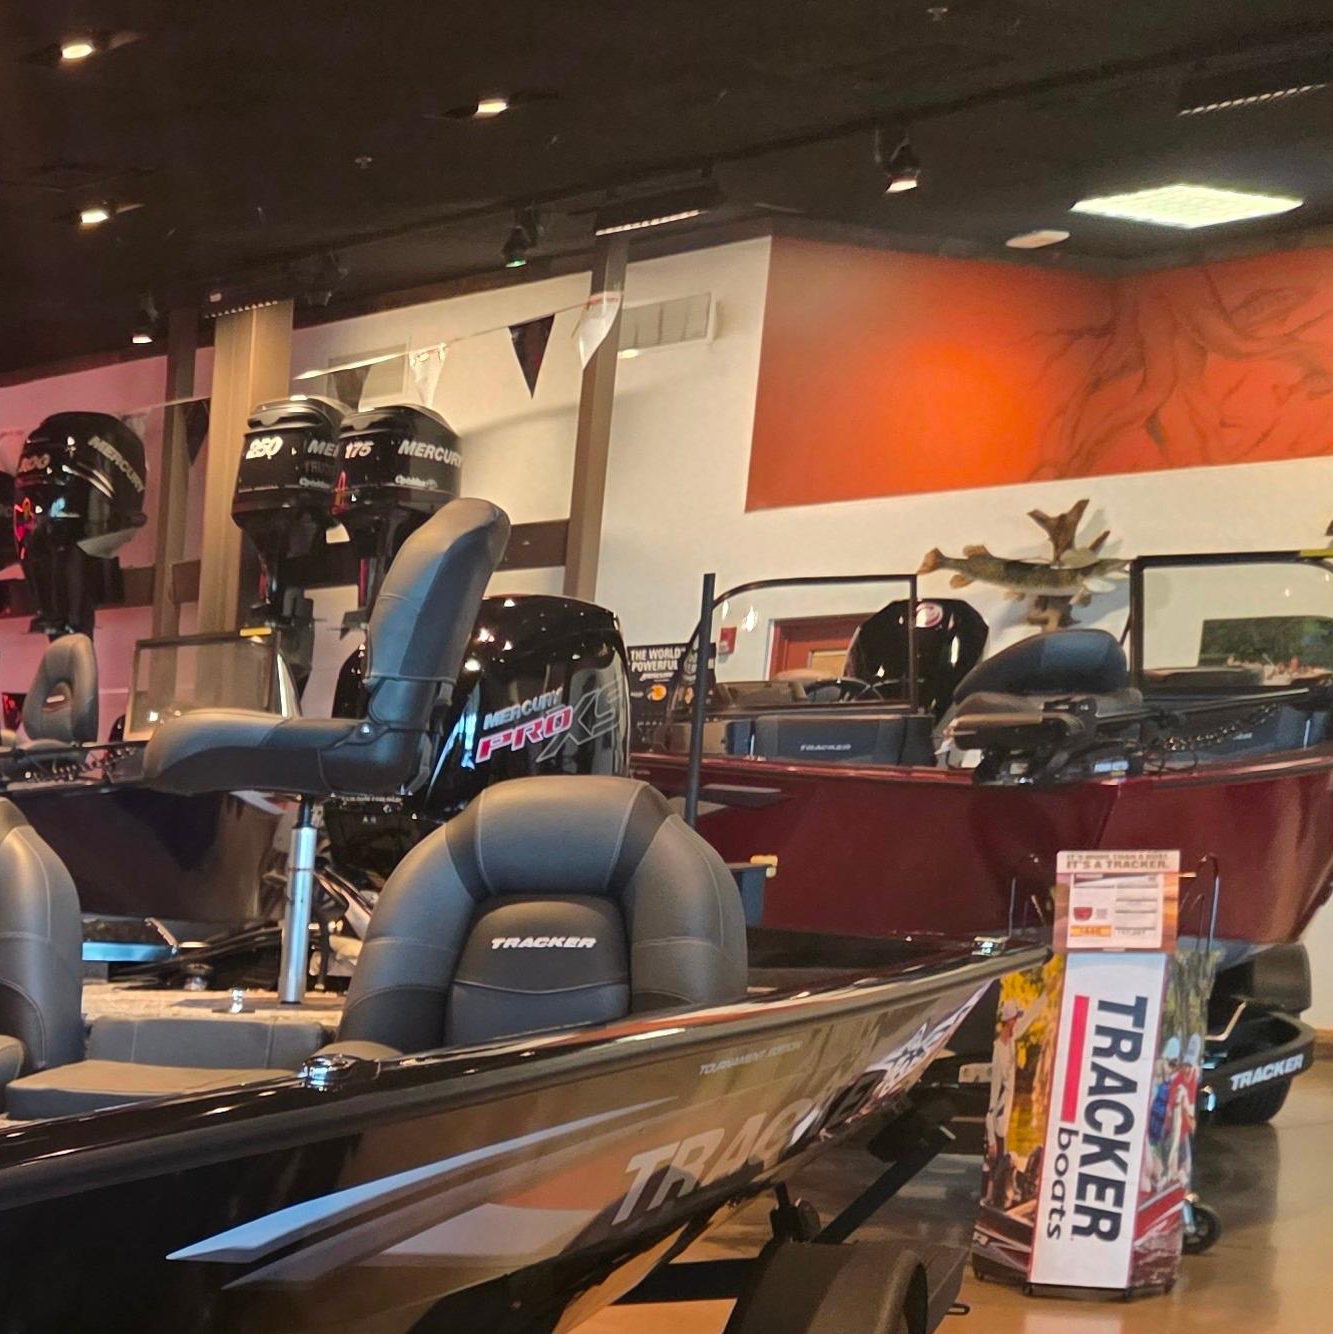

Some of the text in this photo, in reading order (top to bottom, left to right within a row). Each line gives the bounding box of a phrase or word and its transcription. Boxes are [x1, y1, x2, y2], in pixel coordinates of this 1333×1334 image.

[87, 435, 145, 494] MERCURY
[245, 435, 284, 460] 250
[343, 439, 464, 468] 175 MERCURY
[630, 649, 648, 661] THE
[483, 686, 564, 731] MERCURY
[475, 705, 574, 764] PRO
[1066, 861, 1170, 869] IT'S A TRACKER.
[491, 936, 597, 949] TRACKER
[1230, 1053, 1305, 1091] TRACKER
[1071, 994, 1149, 1243] TRACKER
[1045, 1127, 1080, 1241] boats
